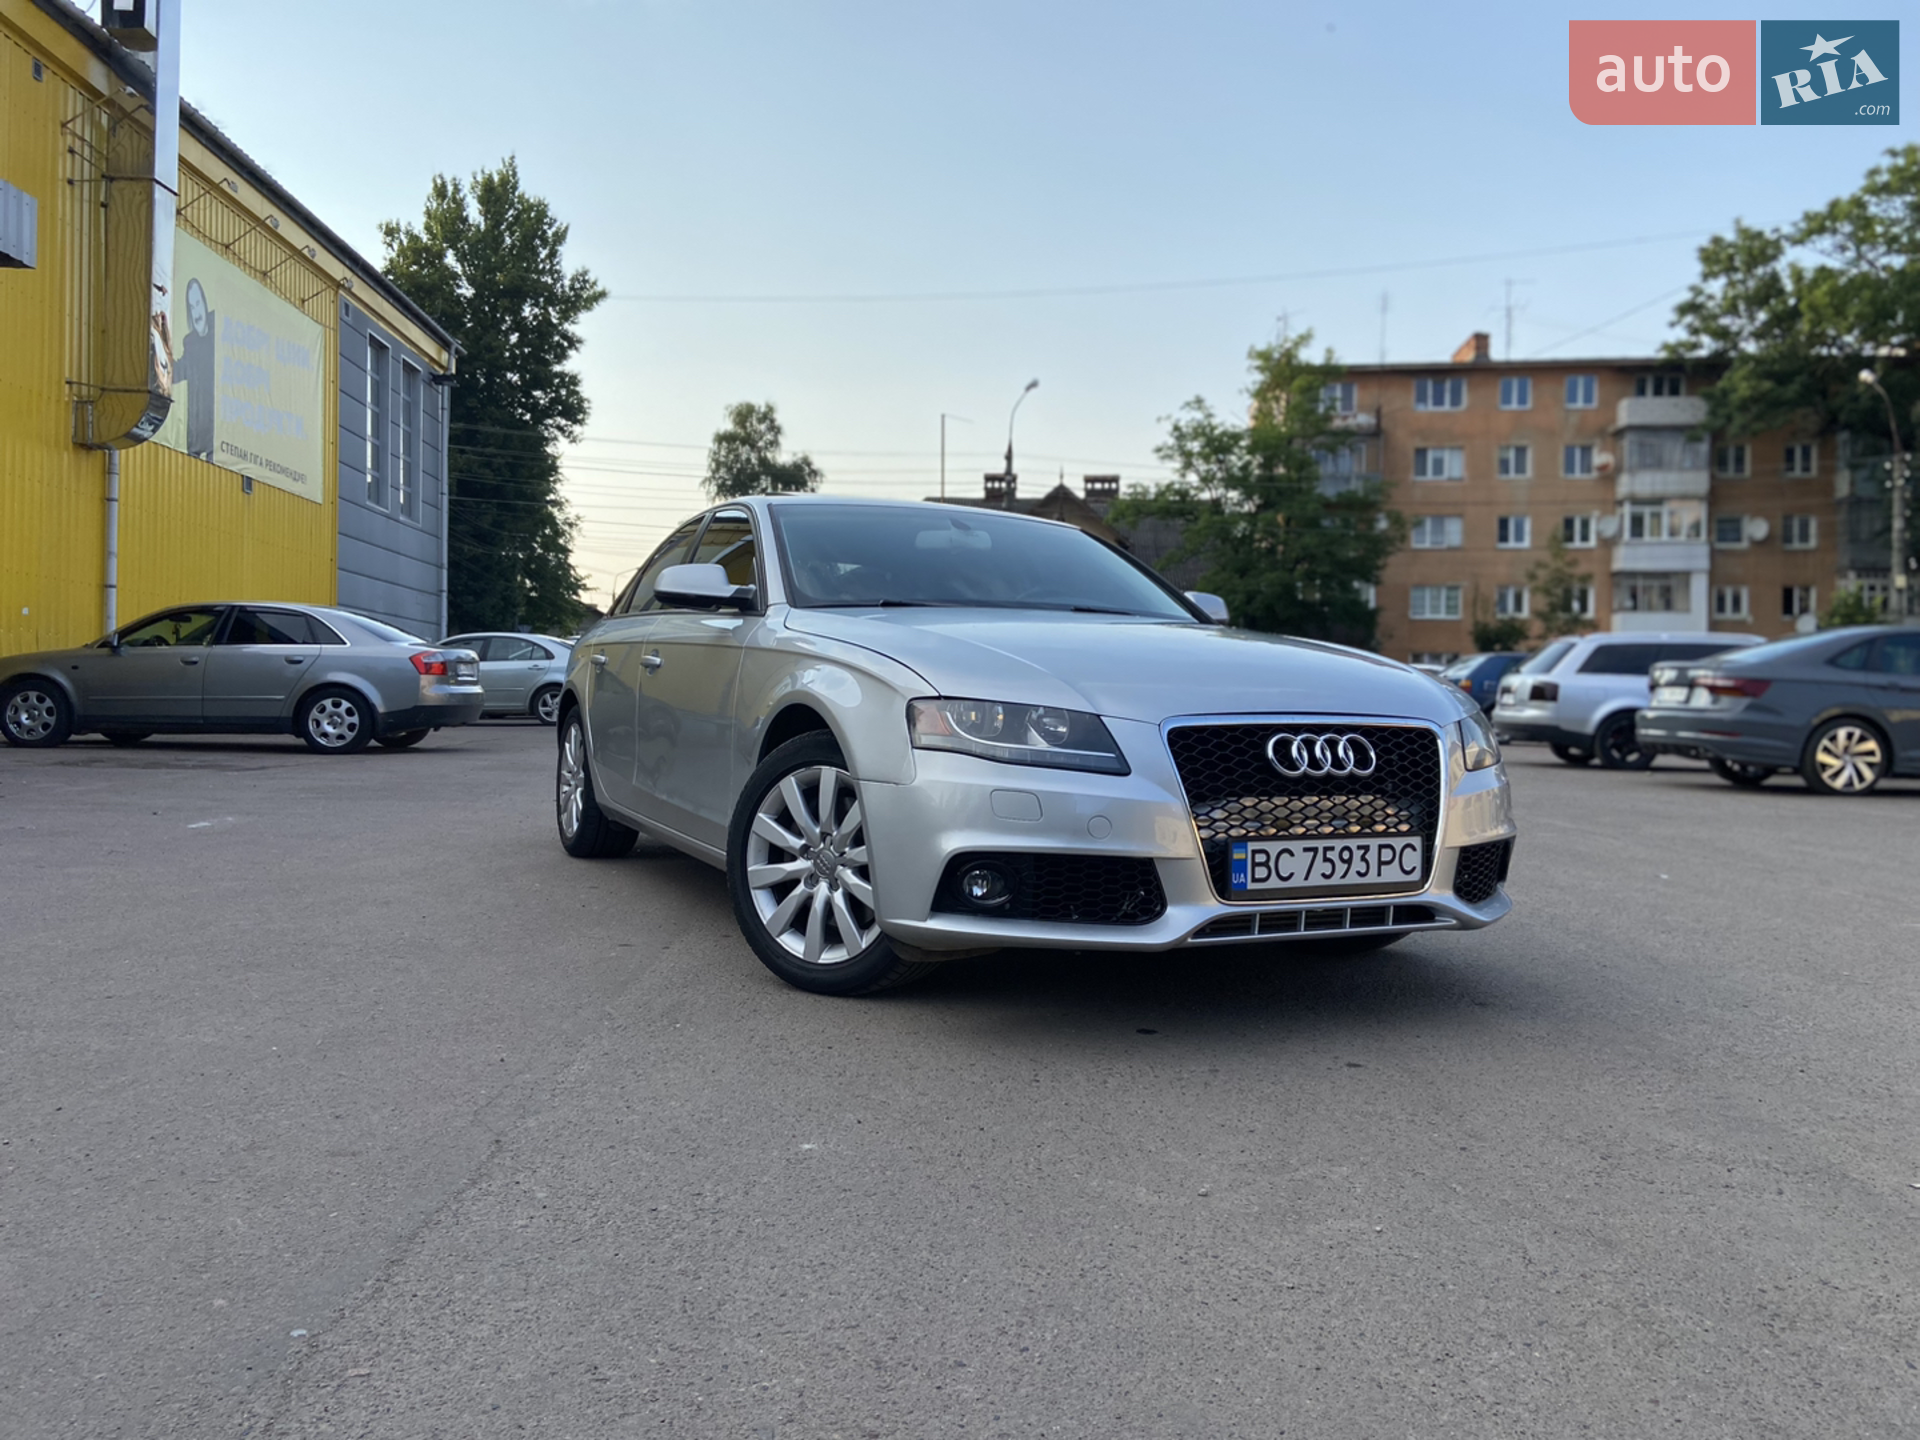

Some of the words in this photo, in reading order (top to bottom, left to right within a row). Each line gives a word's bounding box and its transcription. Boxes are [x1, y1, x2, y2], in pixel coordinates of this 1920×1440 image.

[220, 440, 249, 462] СТЕПАН
[1302, 844, 1371, 882] 7593
[1232, 872, 1246, 884] UA
